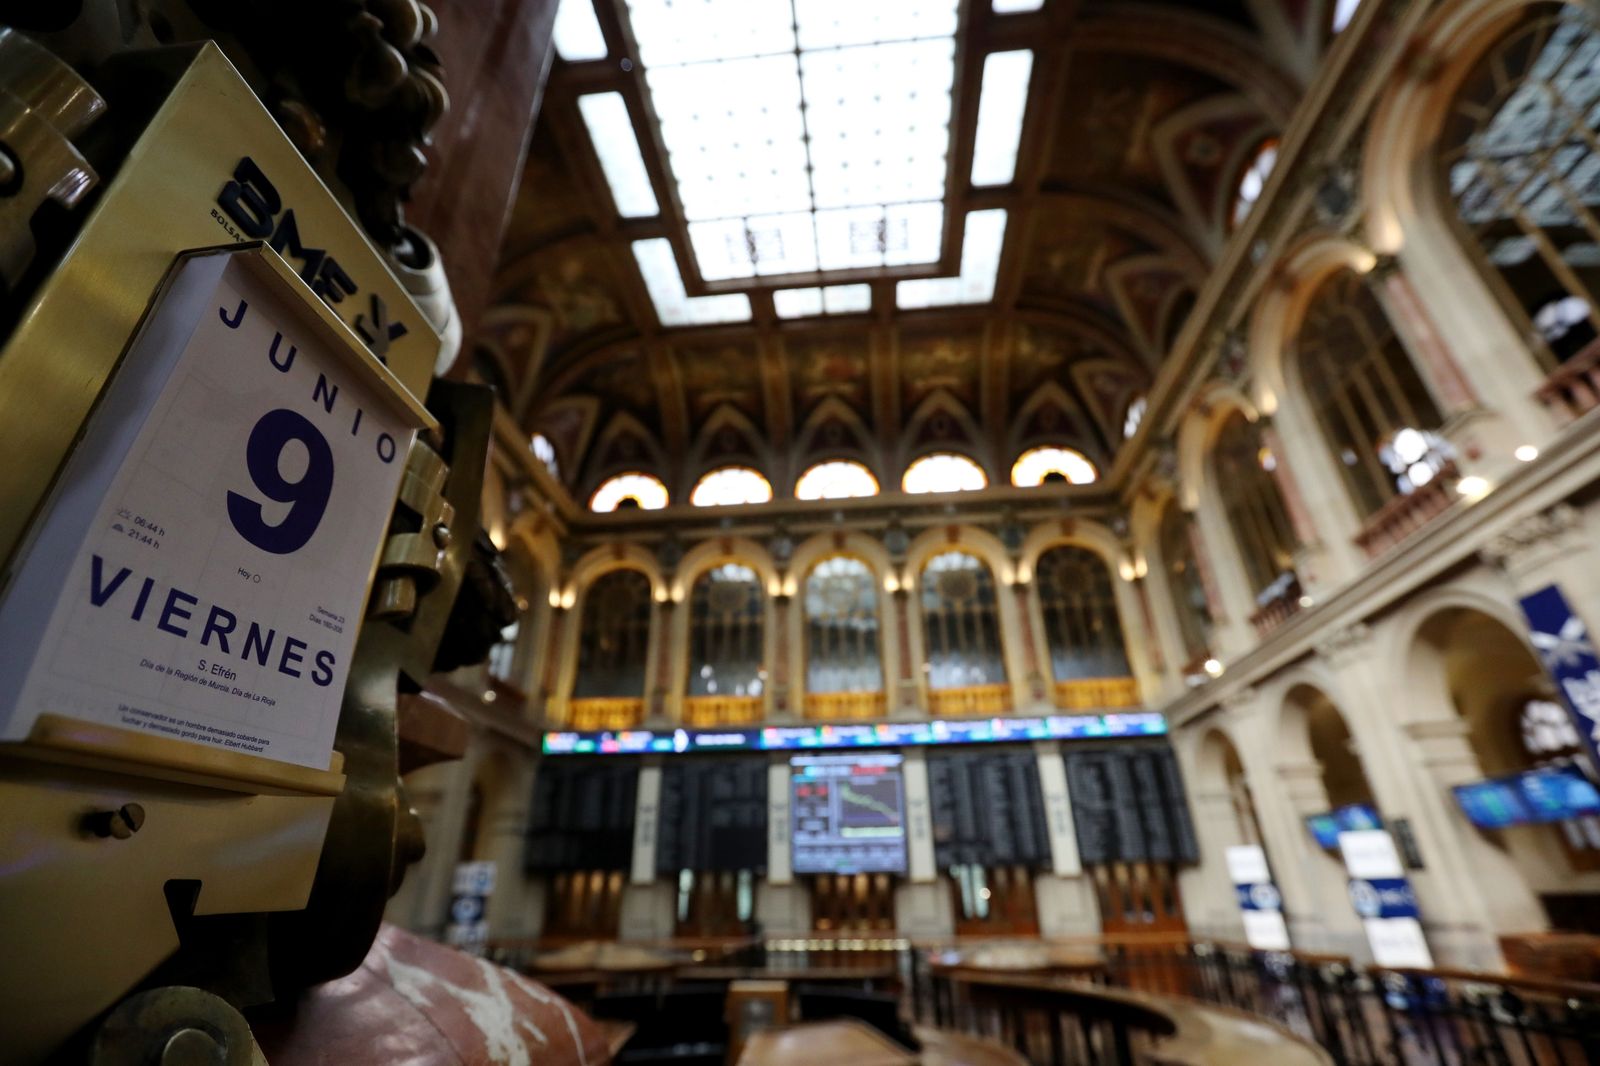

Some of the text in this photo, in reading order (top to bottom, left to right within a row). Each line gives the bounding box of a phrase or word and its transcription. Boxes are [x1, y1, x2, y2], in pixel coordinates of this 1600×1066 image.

[219, 299, 396, 463] JUNIO
[227, 408, 334, 555] 9
[237, 567, 251, 580] Hoy
[90, 554, 336, 687] VIERNES
[155, 664, 165, 673] de
[166, 667, 173, 675] la
[174, 669, 198, 683] Región
[198, 677, 207, 686] de
[231, 687, 242, 697] Día
[243, 691, 252, 699] de
[252, 693, 261, 702] La
[261, 696, 276, 706] Rioja
[198, 659, 237, 680] S. Efrén
